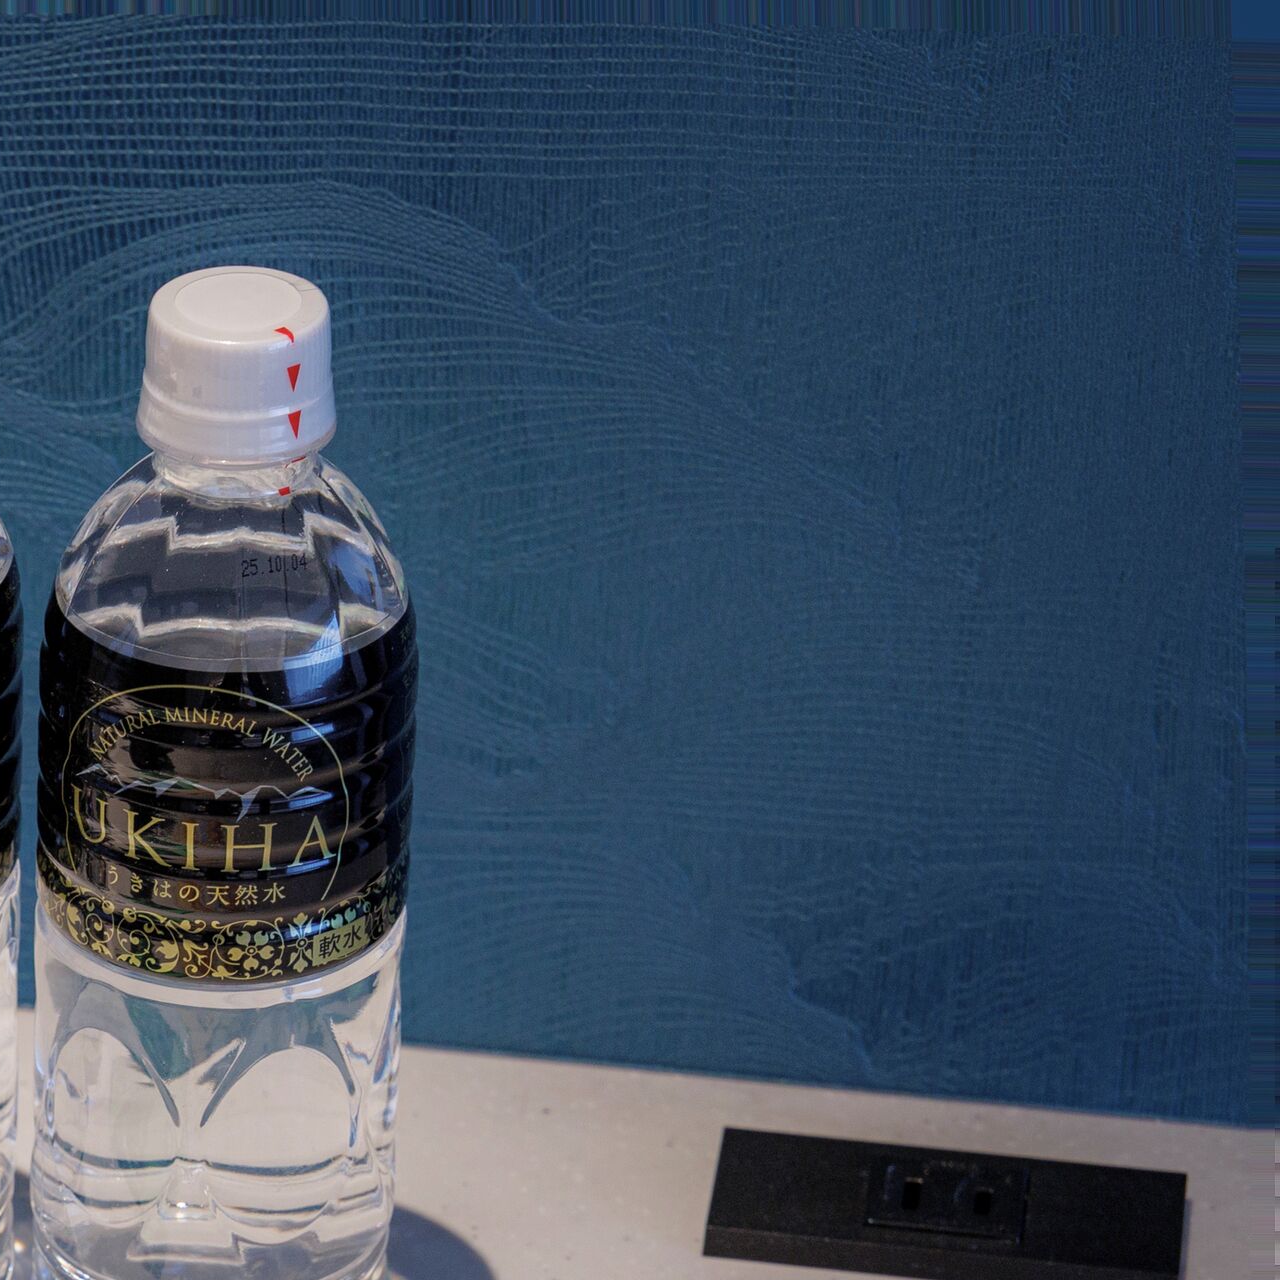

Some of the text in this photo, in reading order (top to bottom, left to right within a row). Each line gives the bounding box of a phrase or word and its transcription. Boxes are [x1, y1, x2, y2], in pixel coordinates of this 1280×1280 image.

[240, 552, 308, 578] 25.10.04
[89, 706, 314, 782] NATURAL MINERAL WATER
[71, 784, 336, 872] UKIHA
[108, 865, 286, 906] うきはの天然水
